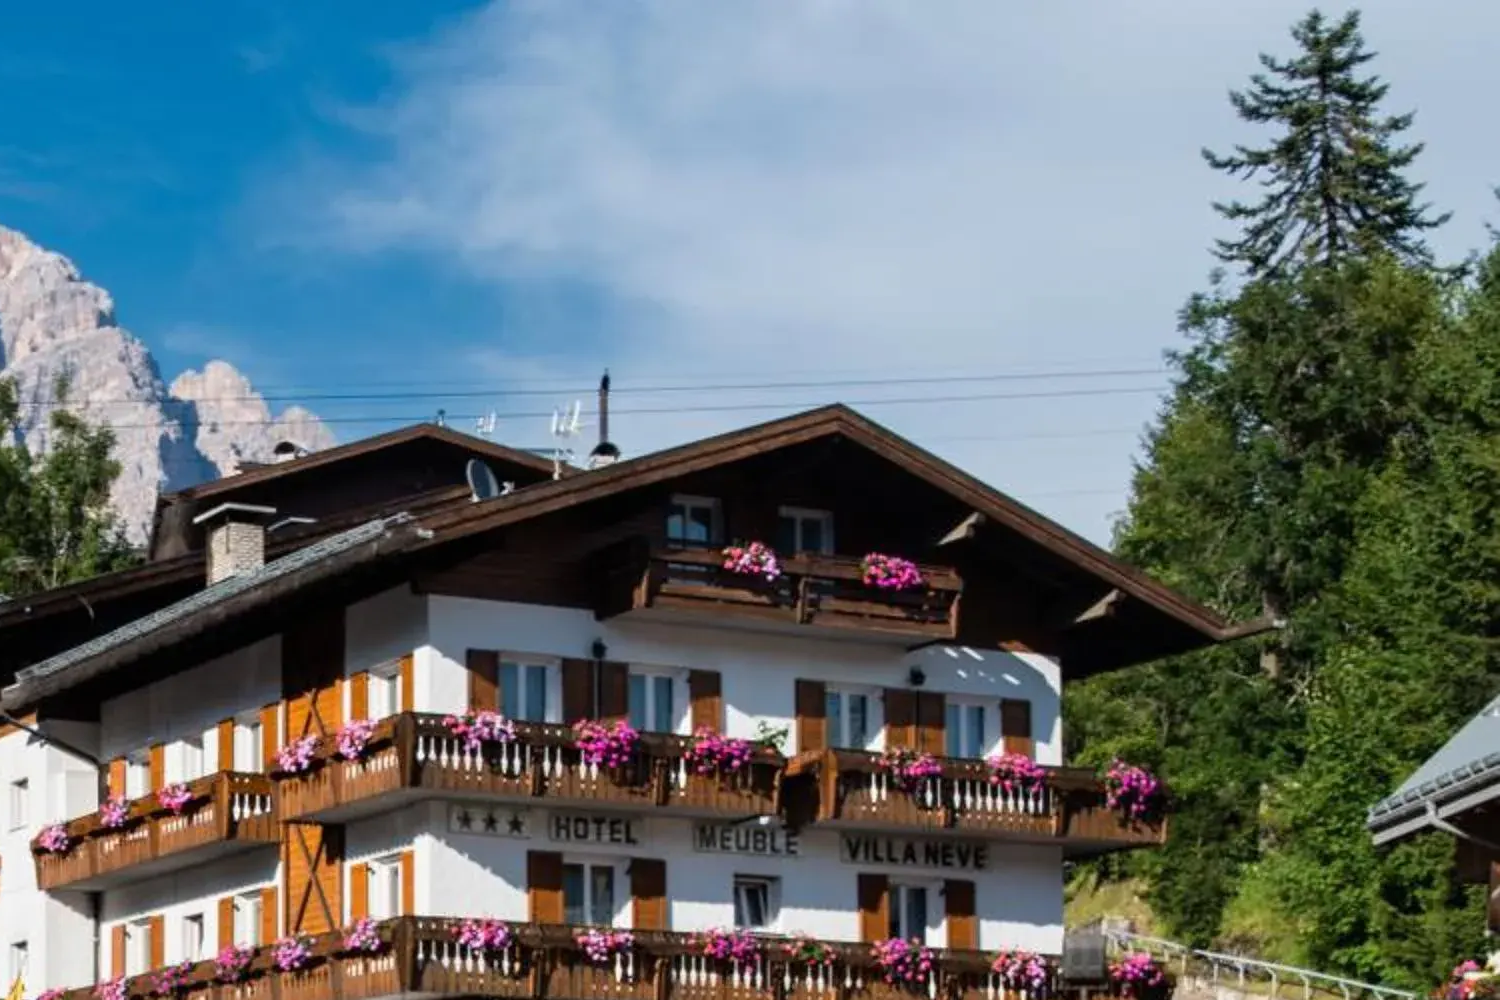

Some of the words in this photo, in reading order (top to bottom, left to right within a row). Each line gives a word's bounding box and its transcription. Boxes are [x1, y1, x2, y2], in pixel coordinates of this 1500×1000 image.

[555, 815, 639, 845] HOTEL
[699, 824, 799, 855] MEUBLE
[845, 835, 917, 864] VILLA
[925, 840, 988, 869] NEVE
